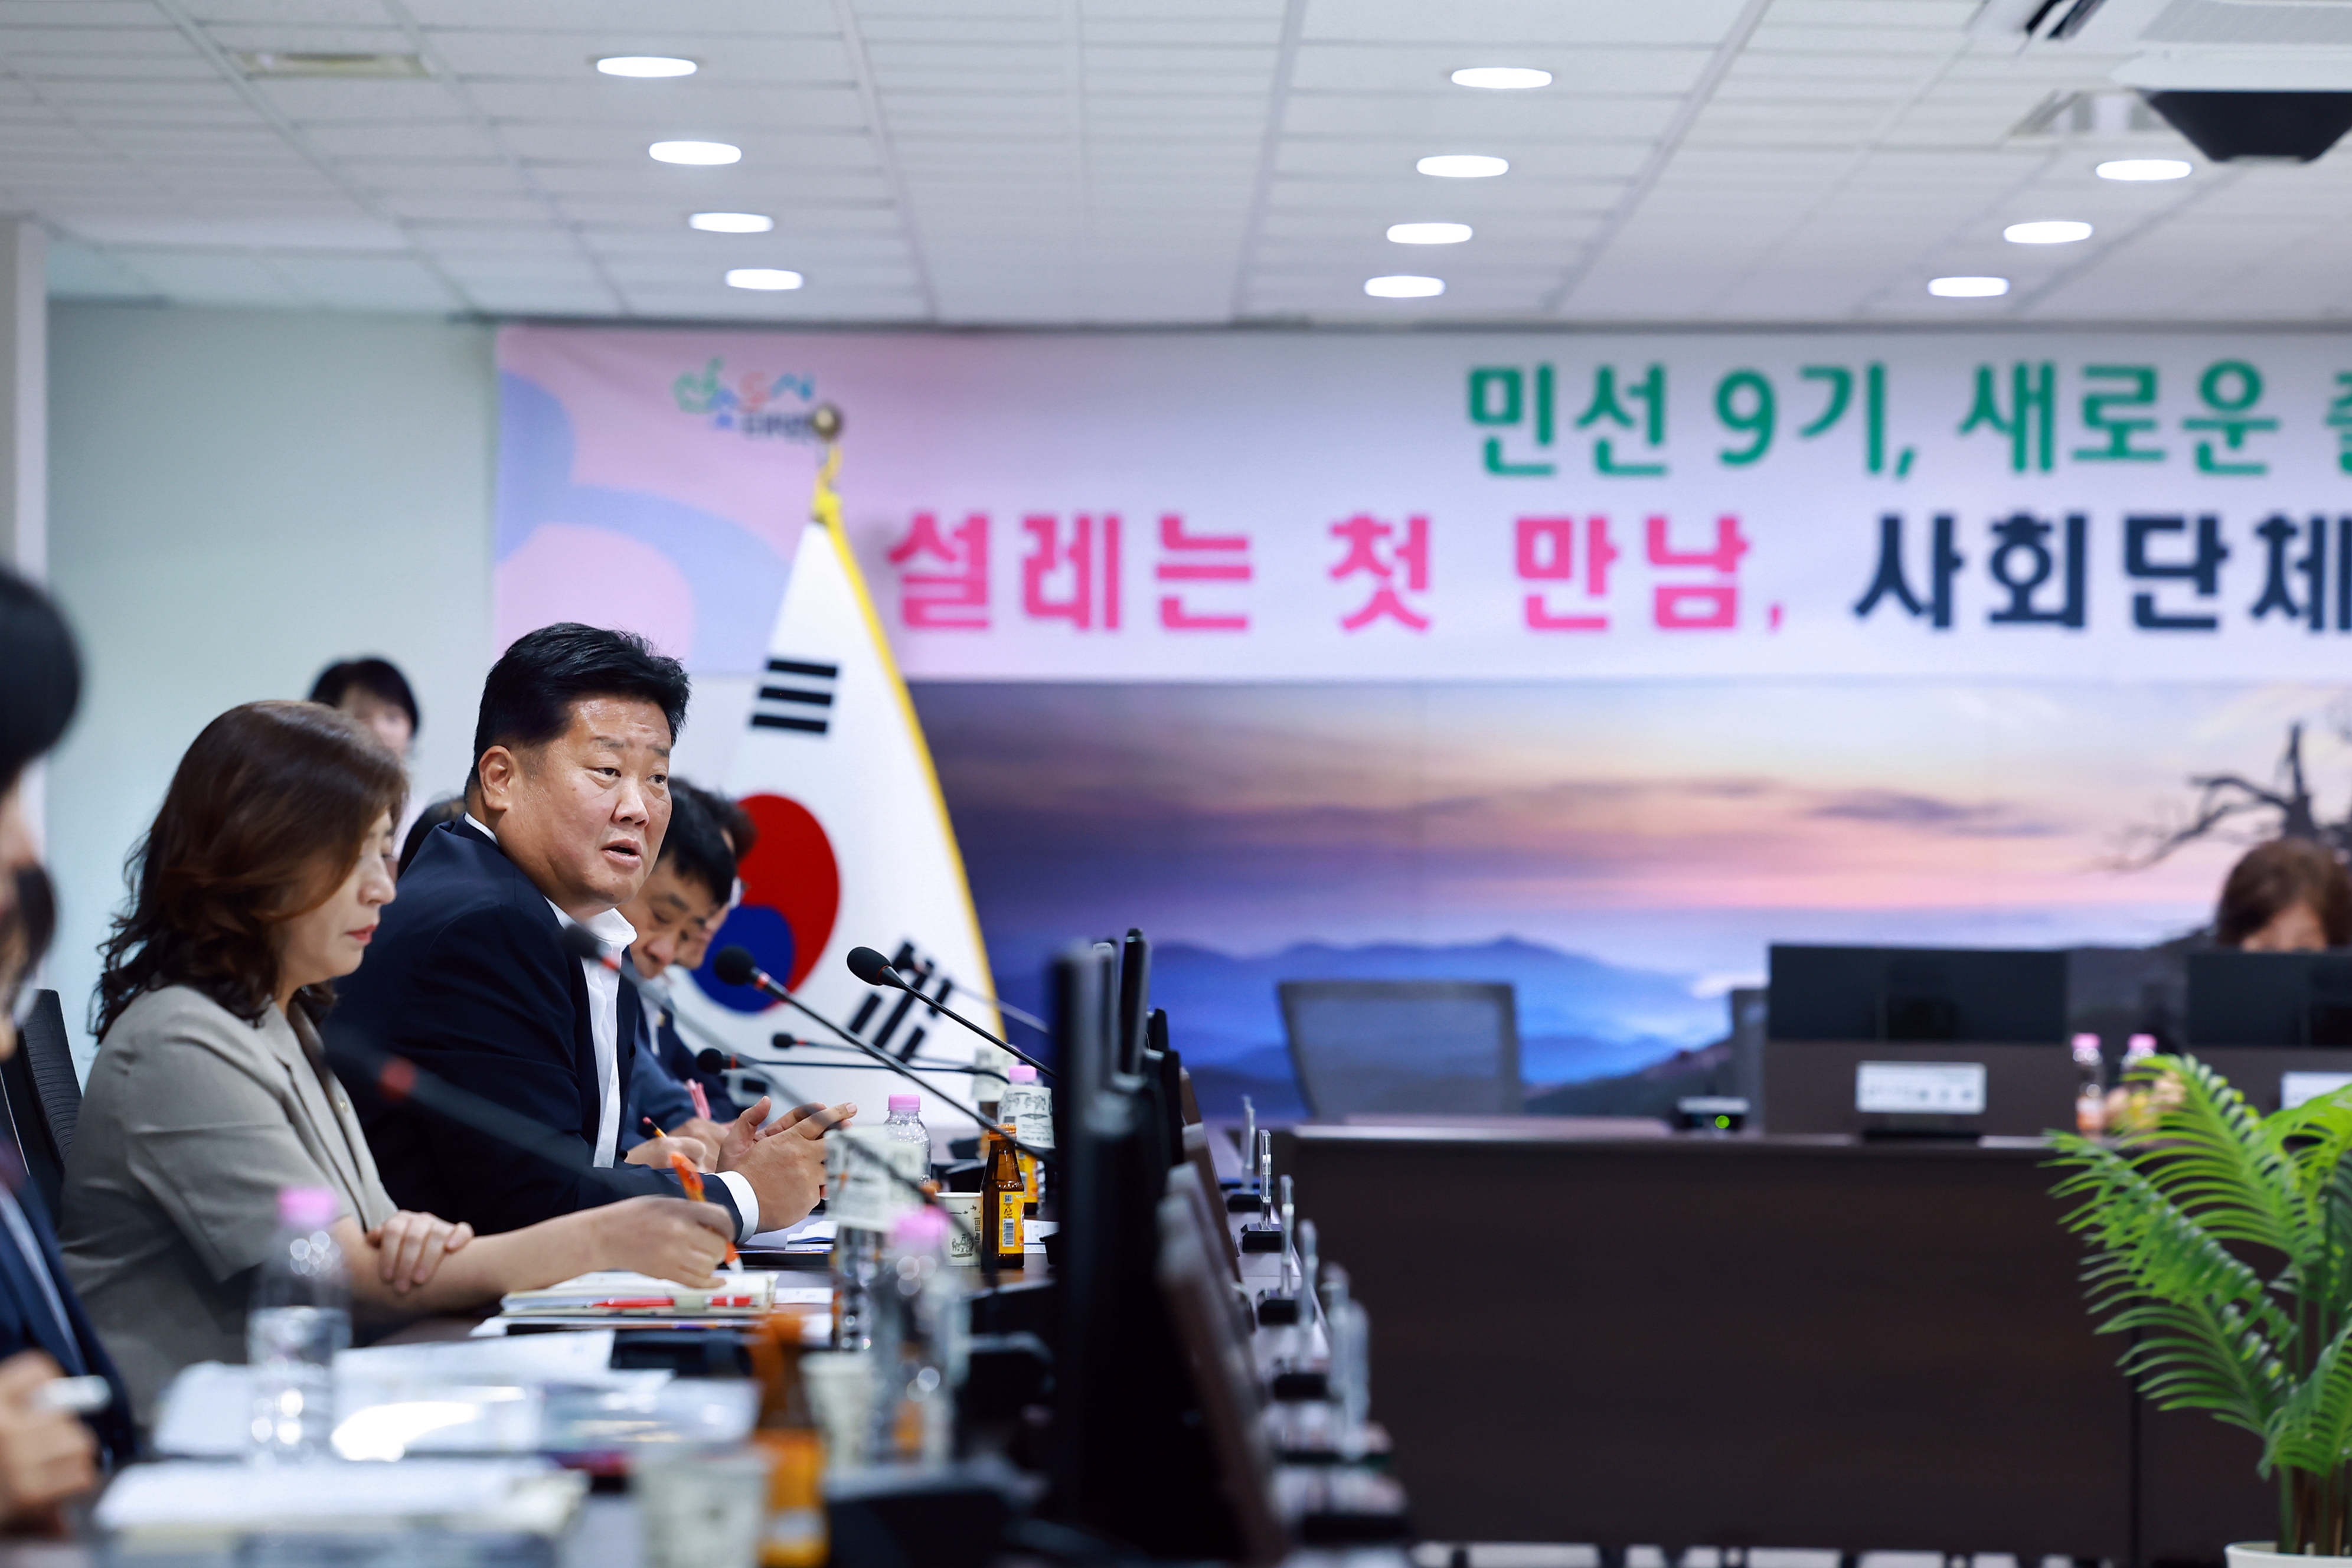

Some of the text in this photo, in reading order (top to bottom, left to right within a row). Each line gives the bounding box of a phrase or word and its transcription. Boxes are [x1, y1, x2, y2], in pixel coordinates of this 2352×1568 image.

[1467, 362, 1667, 477] 민선
[1713, 362, 1916, 479] 9기,
[1959, 360, 2279, 476] 새로운
[887, 512, 2352, 632] 설레는 첫 만남, 사회단체
